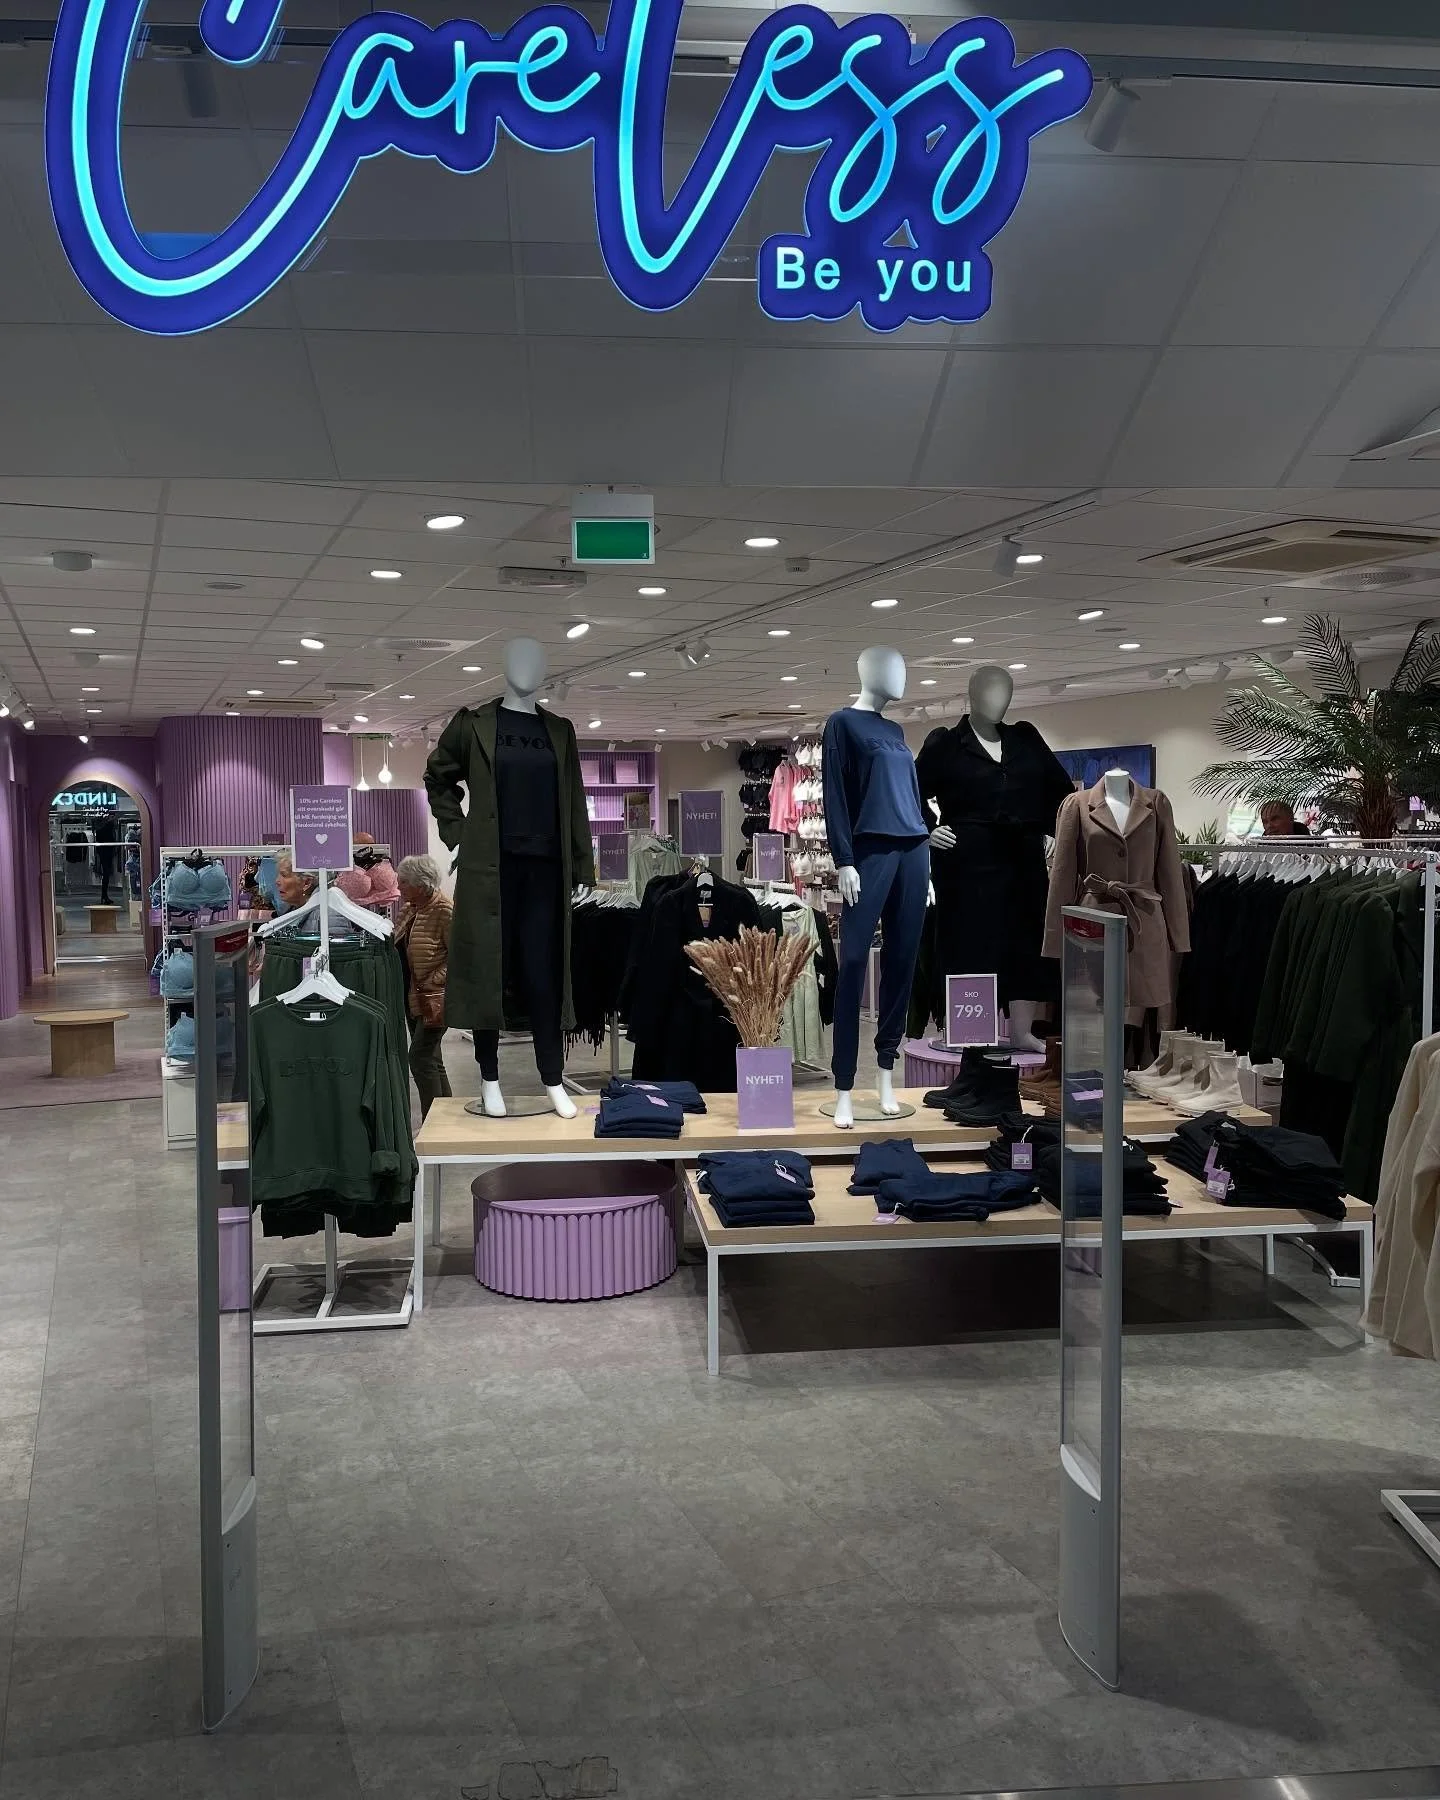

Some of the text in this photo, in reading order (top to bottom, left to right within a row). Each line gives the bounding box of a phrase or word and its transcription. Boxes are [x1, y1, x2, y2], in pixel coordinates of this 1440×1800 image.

[775, 246, 972, 302] Be you
[686, 812, 717, 820] NYHET!
[745, 1075, 784, 1085] NYHET!
